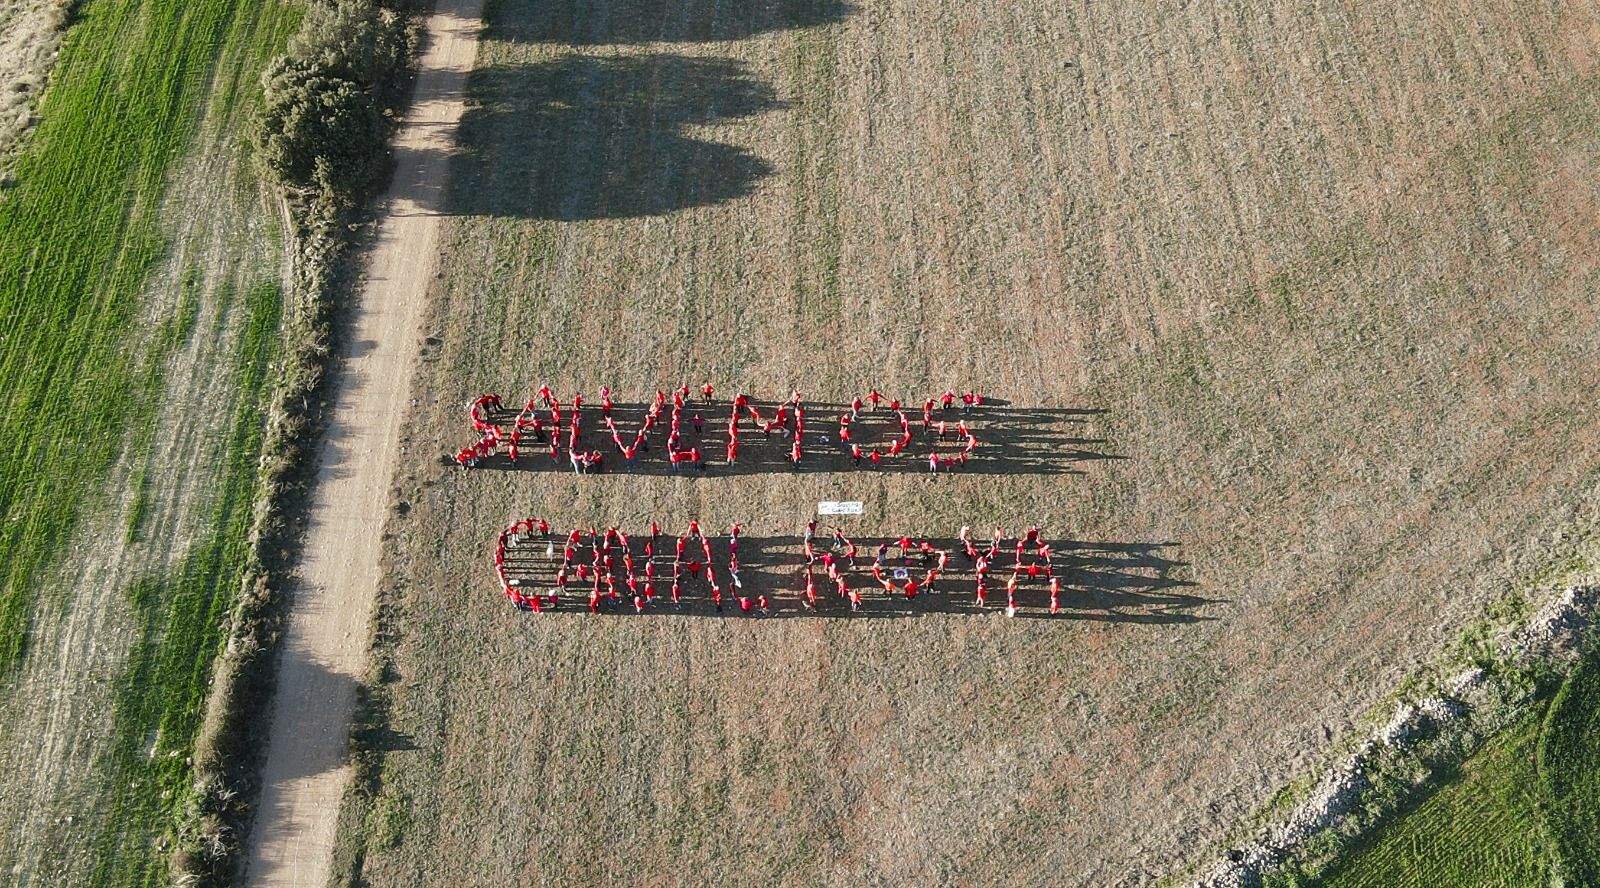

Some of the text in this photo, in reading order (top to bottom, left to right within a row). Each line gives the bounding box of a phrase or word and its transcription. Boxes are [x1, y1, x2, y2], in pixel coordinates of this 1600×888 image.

[451, 384, 985, 474] SALVEMOS
[494, 517, 1060, 618] CANAL ROYA
